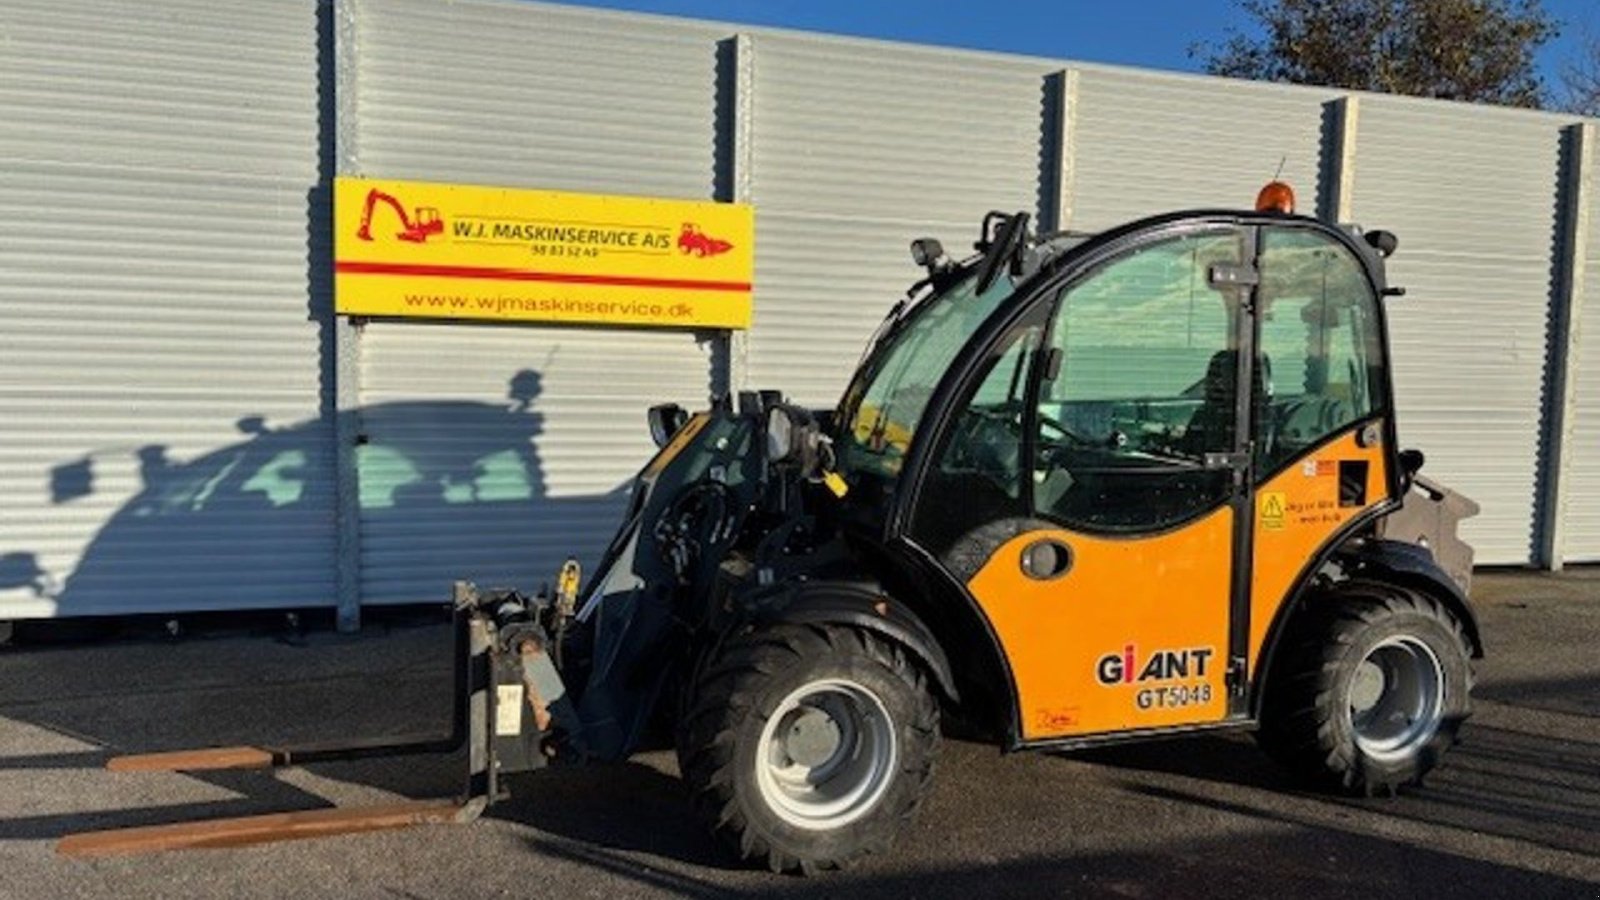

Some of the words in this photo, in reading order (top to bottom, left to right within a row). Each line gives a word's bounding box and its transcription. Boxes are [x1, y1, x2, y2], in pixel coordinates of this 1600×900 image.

[453, 221, 487, 238] W.J.
[492, 224, 637, 247] MASKINSERVICE
[642, 232, 670, 249] A/S
[404, 293, 693, 319] www.wjmaskinservice.dk
[1137, 684, 1211, 709] GT5048
